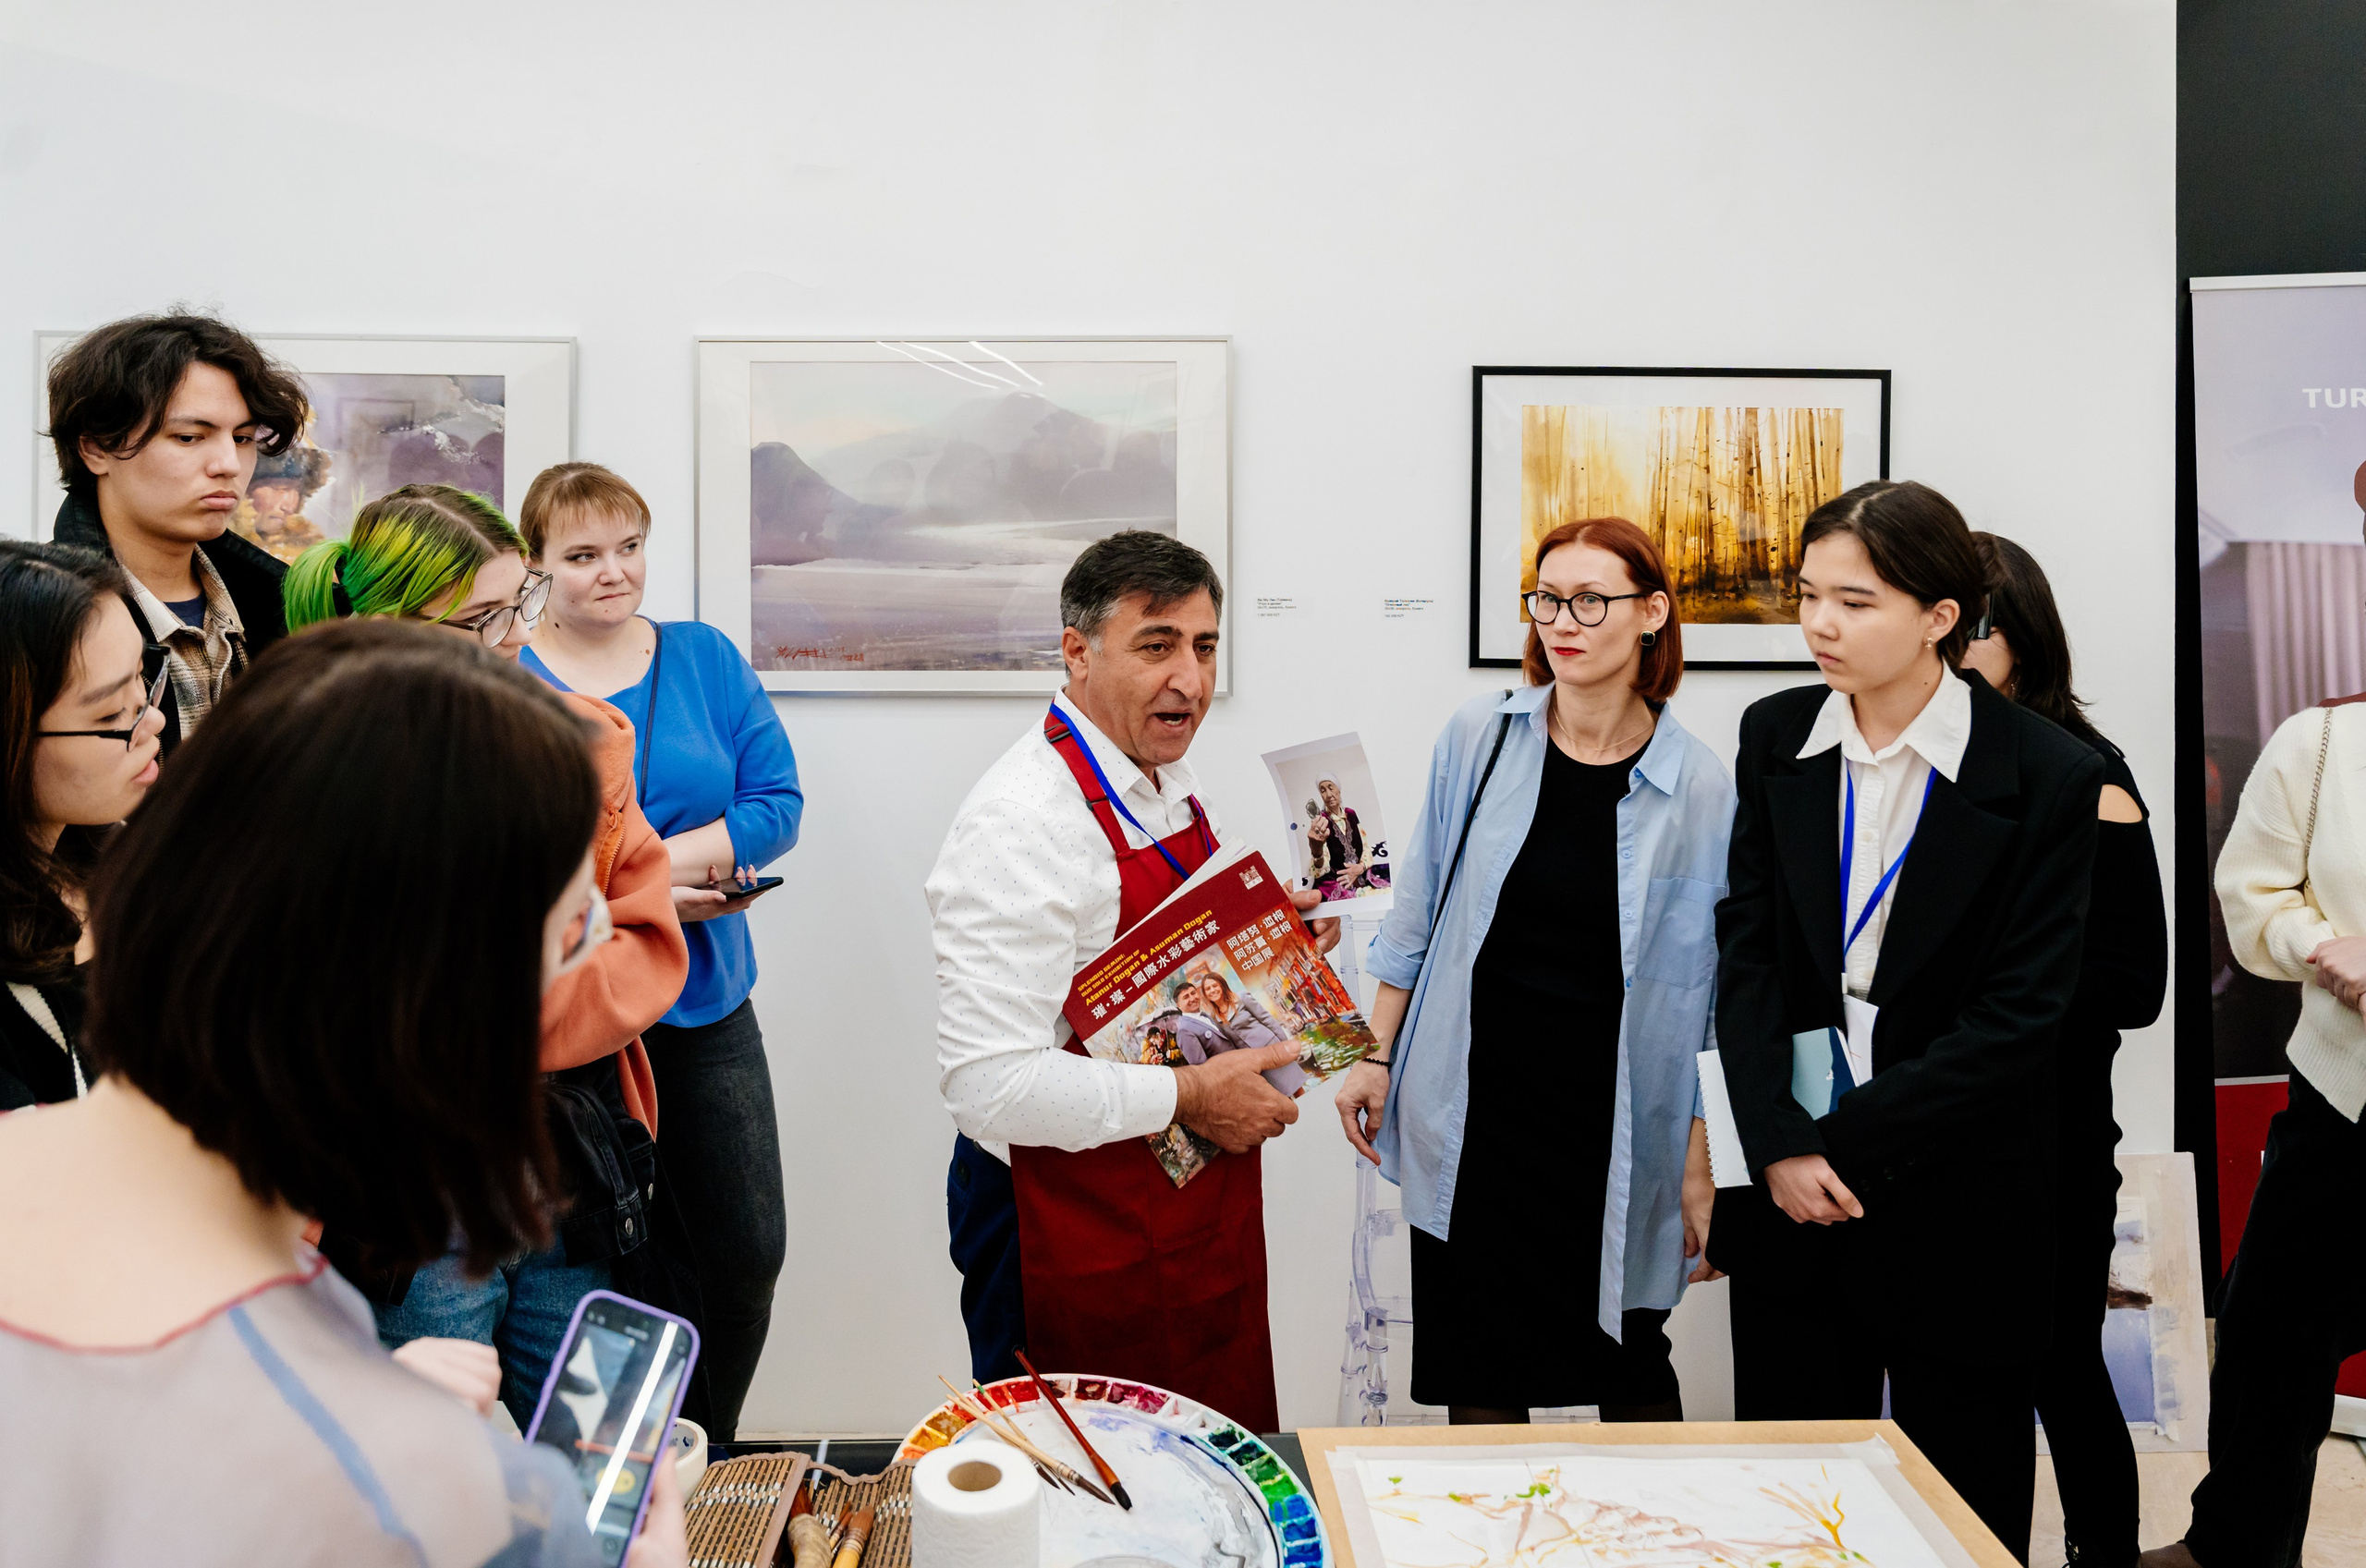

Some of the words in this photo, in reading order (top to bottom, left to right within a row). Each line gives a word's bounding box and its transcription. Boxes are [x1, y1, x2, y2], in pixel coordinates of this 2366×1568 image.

[1078, 970, 1104, 991] SPLENDID
[1104, 954, 1126, 972] GEMINI:
[1081, 987, 1092, 997] DUO
[1092, 978, 1105, 989] SOLO
[1104, 954, 1134, 979] EXHIBITION
[1133, 949, 1140, 957] OF
[1085, 982, 1113, 1006] Atanur
[1113, 960, 1140, 983] Dogan
[1140, 954, 1149, 962] &
[1150, 928, 1184, 955] Asuman
[1183, 909, 1213, 930] Dogan
[1241, 946, 1274, 971] 中国展
